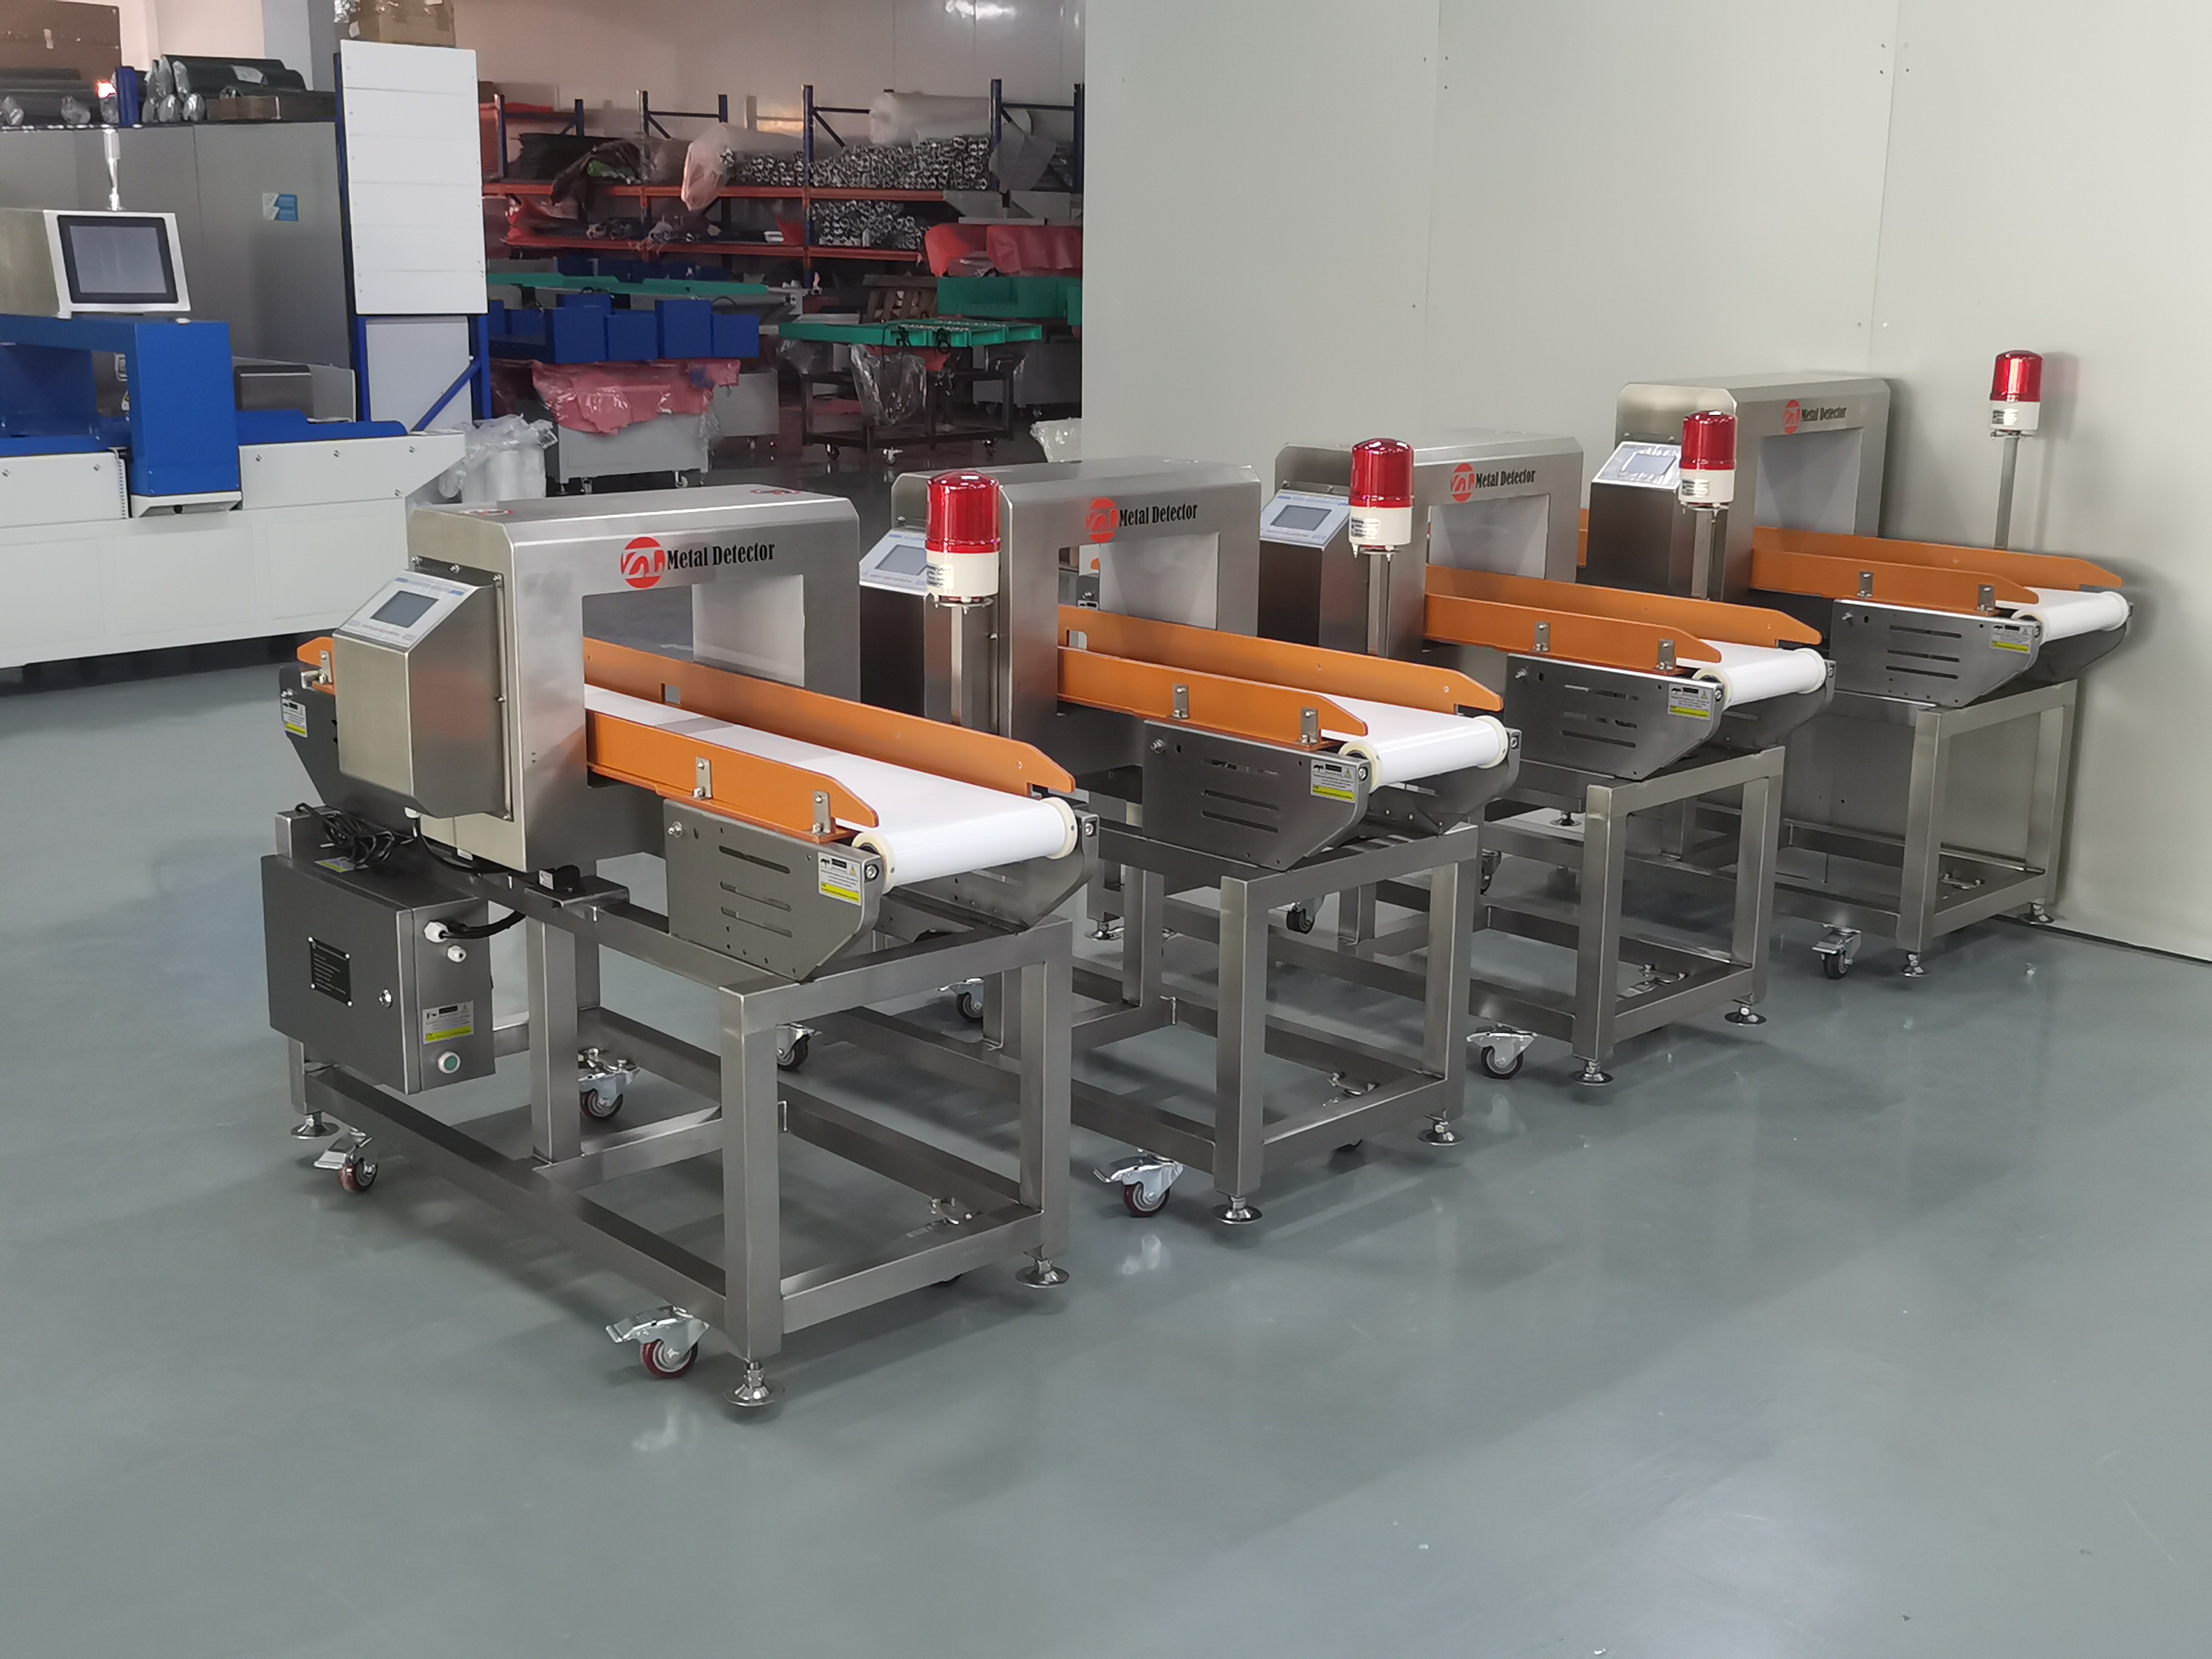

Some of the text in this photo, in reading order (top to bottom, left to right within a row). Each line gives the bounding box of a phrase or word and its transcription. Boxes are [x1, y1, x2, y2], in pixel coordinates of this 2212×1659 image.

[1475, 468, 1536, 489] Metal Detector
[1119, 503, 1198, 527] Metal Detector
[666, 542, 775, 570] Metal Detector
